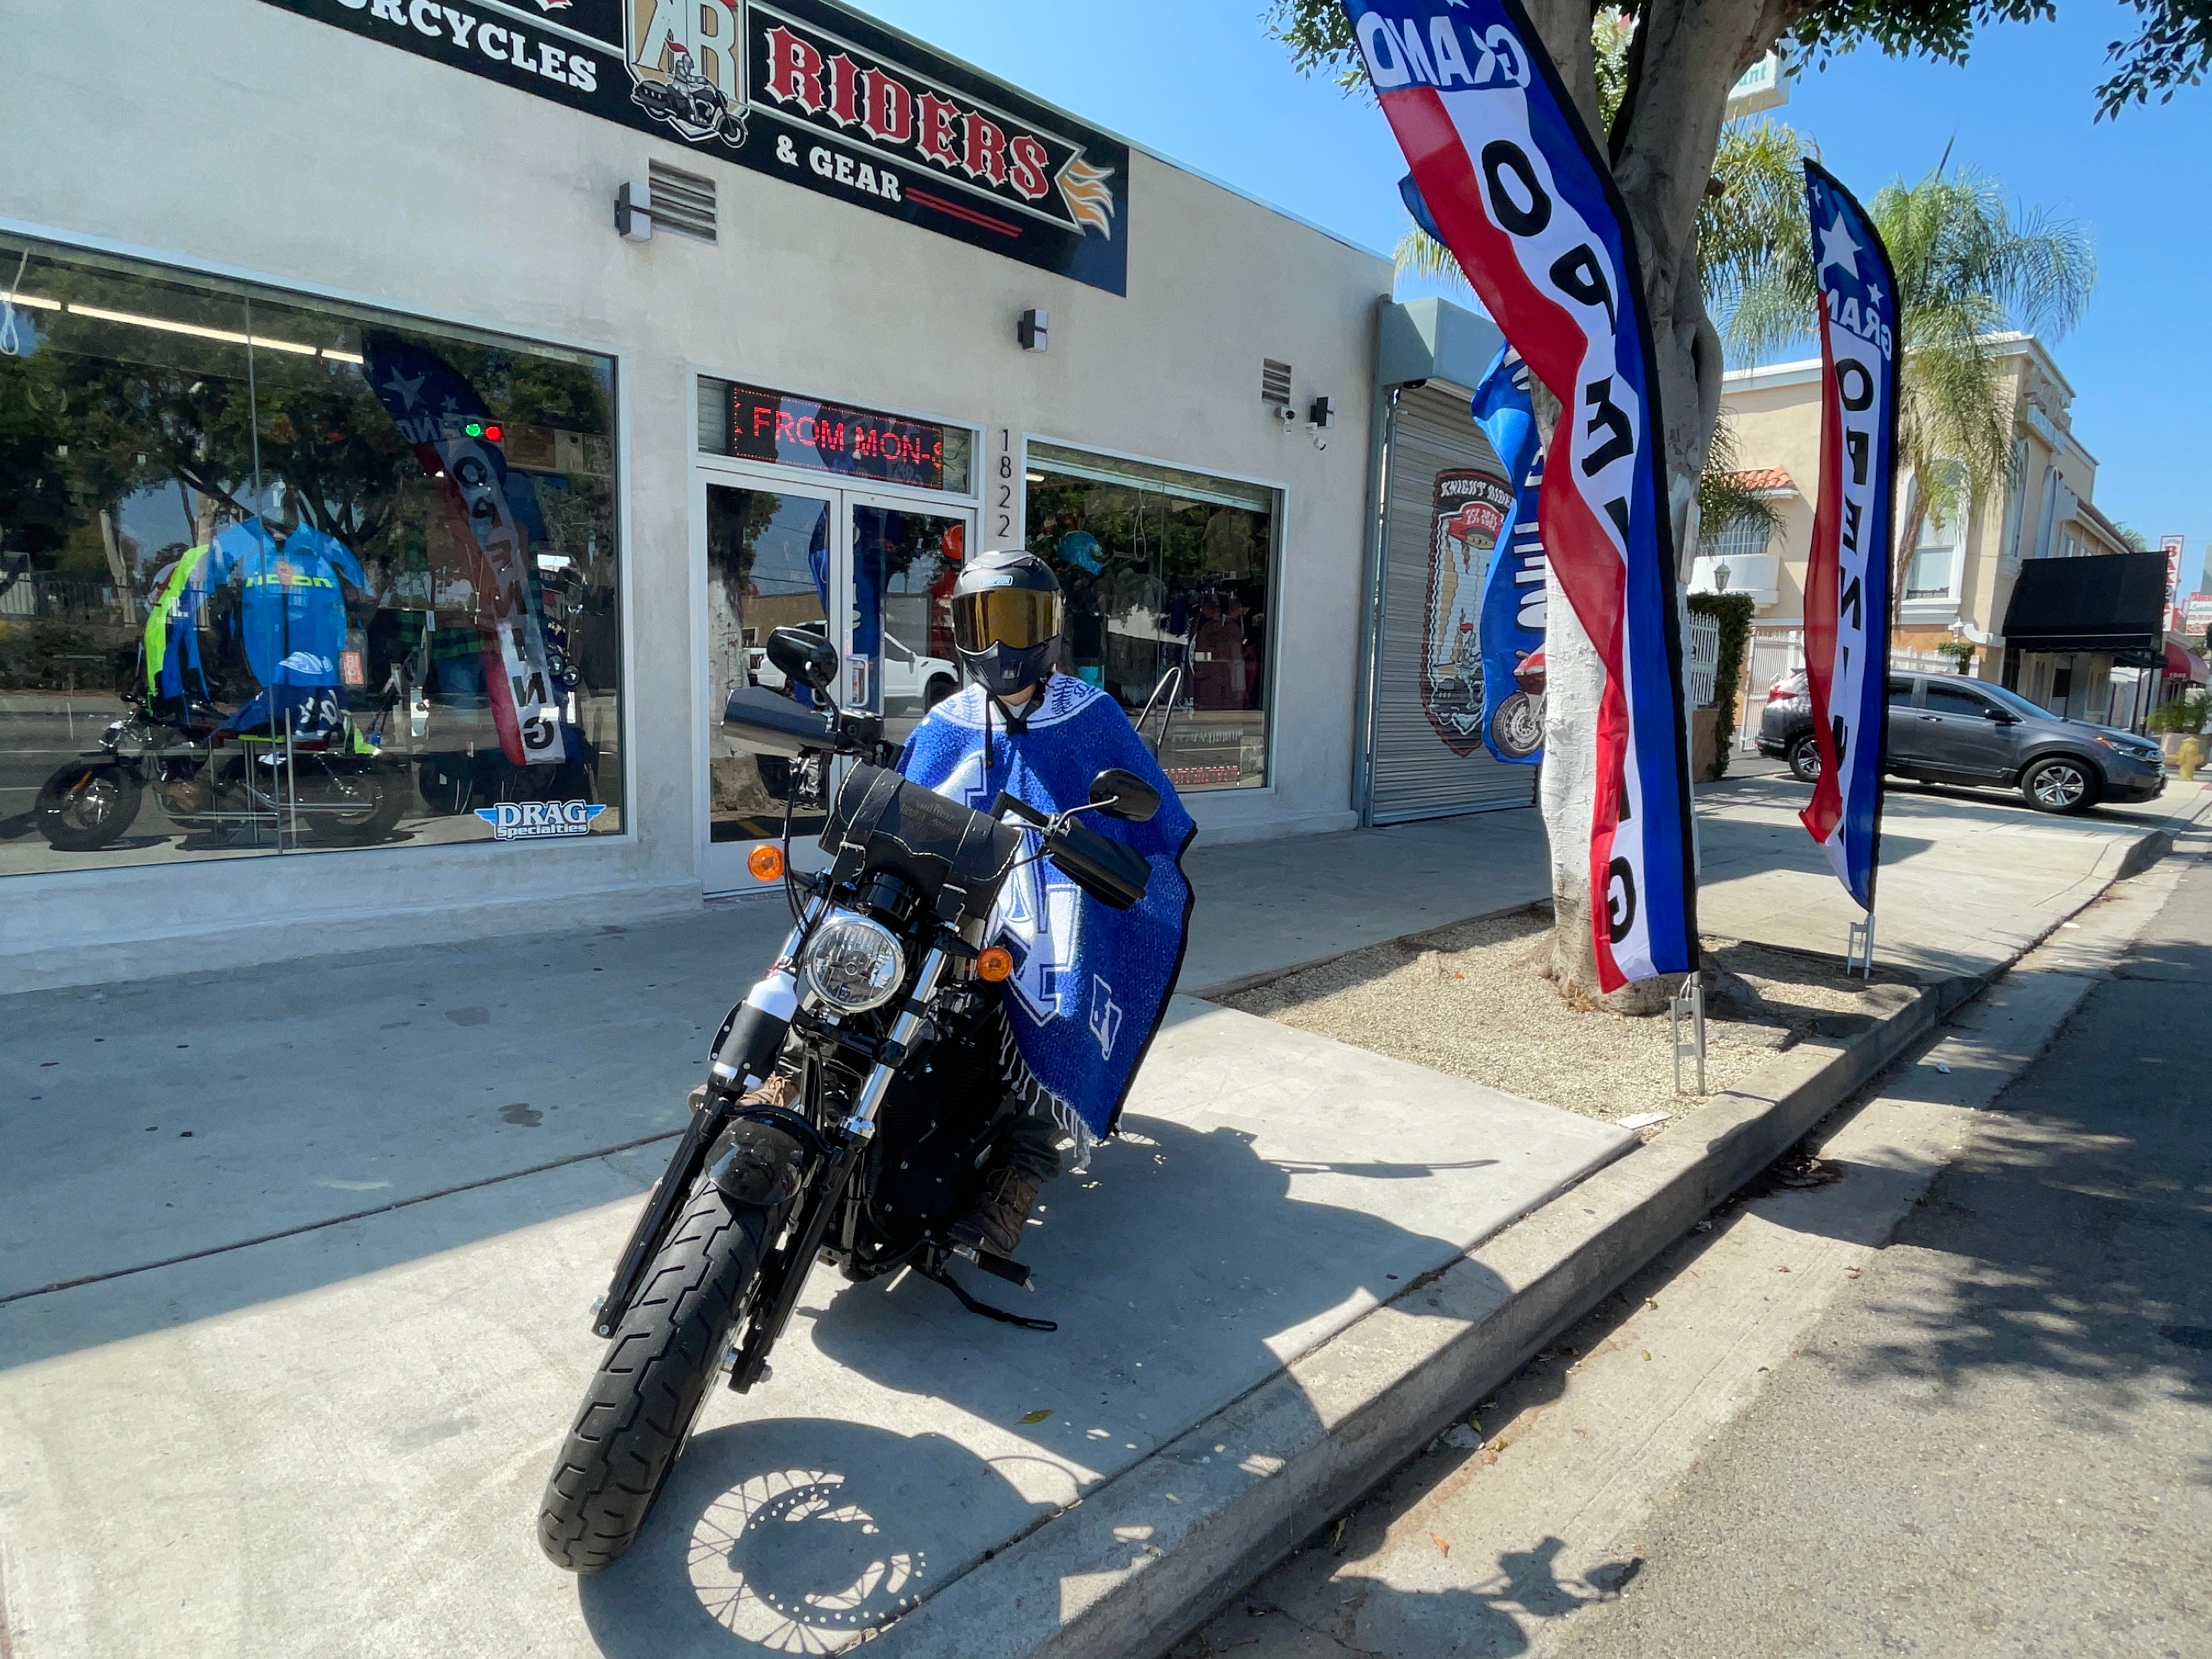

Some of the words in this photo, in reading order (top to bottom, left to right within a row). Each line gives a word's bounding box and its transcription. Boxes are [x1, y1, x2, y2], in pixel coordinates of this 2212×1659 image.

[336, 0, 597, 92] RCYCLES
[764, 25, 1049, 200] RIDERS
[777, 135, 798, 167] &
[810, 146, 901, 202] GEAR
[753, 407, 844, 451] FROM
[997, 429, 1012, 538] 1822
[1441, 479, 1487, 498] KNIGHT
[1487, 484, 1511, 508] RIDE
[496, 803, 587, 825] DRAG
[498, 823, 586, 837] Specialties
